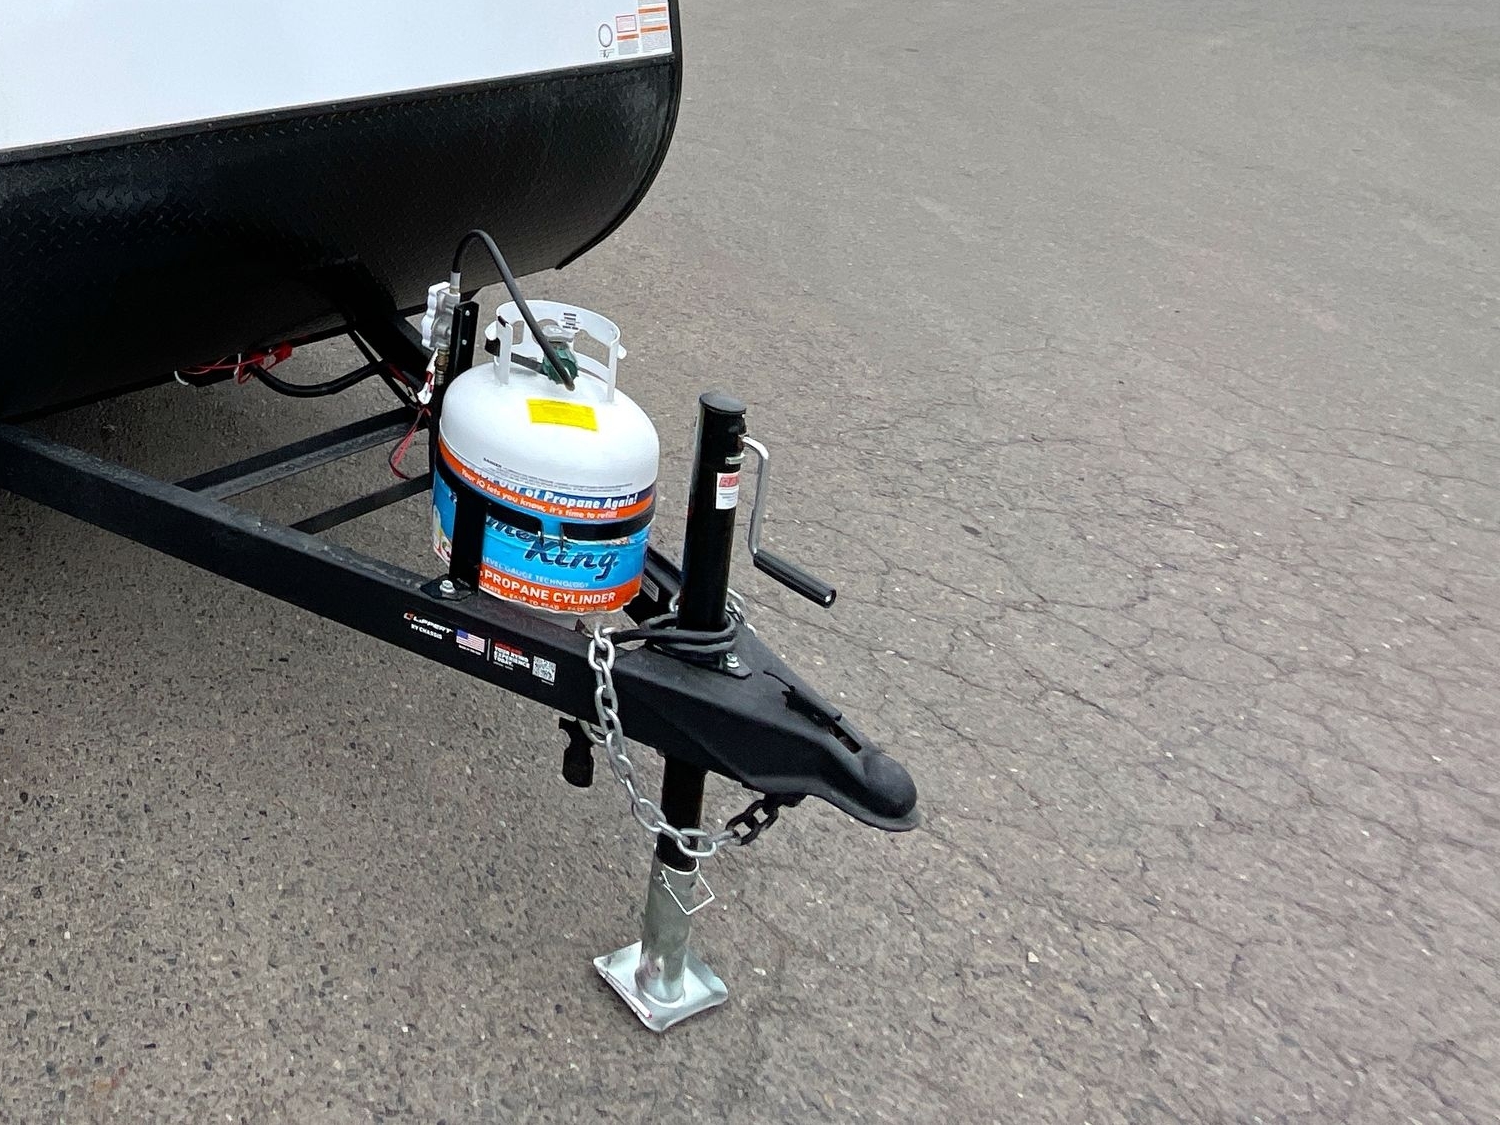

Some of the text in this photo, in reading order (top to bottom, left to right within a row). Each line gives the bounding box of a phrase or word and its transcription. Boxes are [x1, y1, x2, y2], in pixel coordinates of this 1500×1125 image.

[502, 492, 518, 503] you
[543, 491, 601, 510] Propane
[603, 492, 638, 511] Again!
[524, 535, 620, 582] King
[485, 569, 616, 605] PROPANE CYLINDER
[536, 575, 589, 589] TECHNOLOGY
